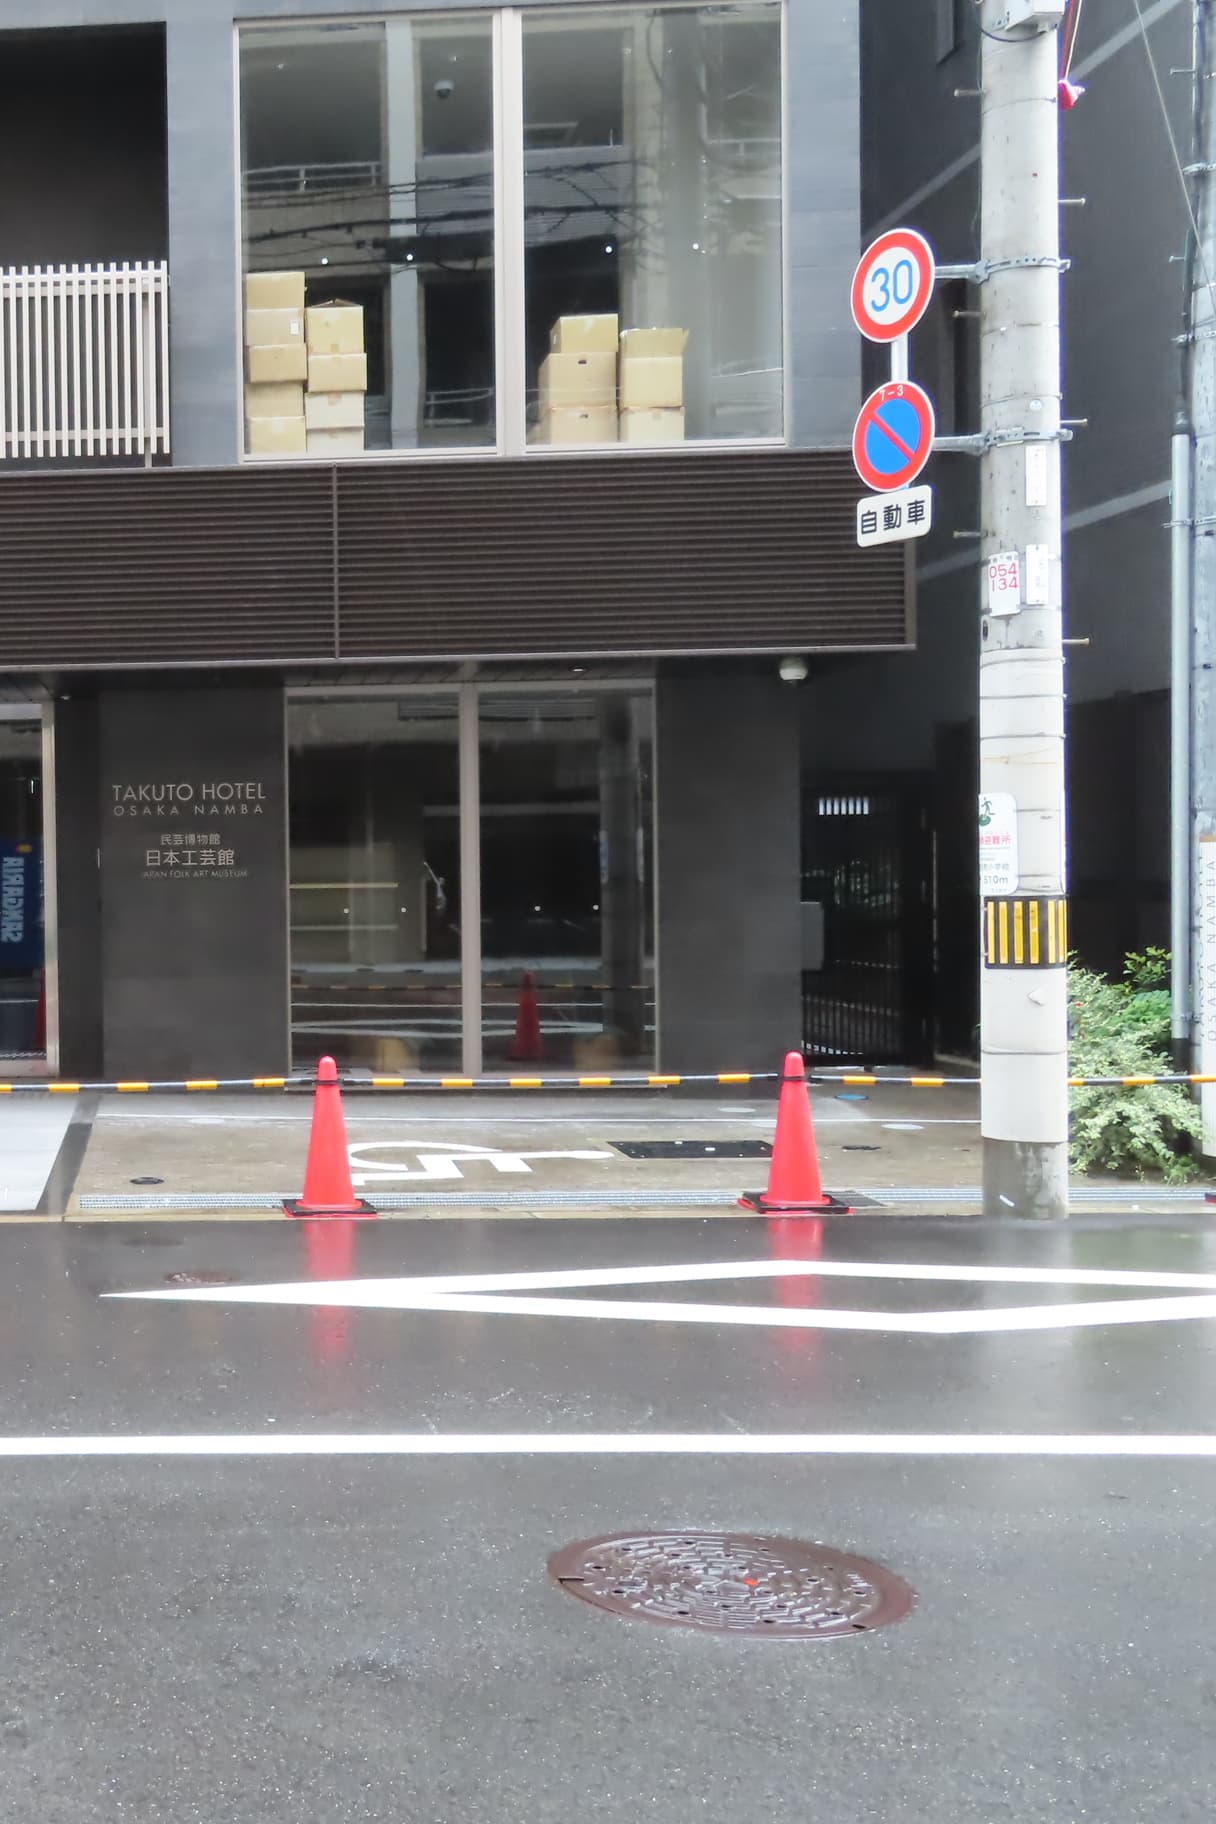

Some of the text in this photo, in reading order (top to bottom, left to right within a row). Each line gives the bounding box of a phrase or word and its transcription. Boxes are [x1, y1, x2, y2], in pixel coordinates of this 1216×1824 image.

[870, 259, 913, 313] 30
[860, 499, 927, 534] 自動車
[989, 563, 1019, 579] 054
[992, 577, 1020, 593] 134
[112, 782, 266, 801] TAKUTO HOTEL
[113, 804, 264, 817] OSAKA NAMBA
[160, 834, 221, 846] 民芸博物館
[145, 849, 235, 867] 日本工芸館
